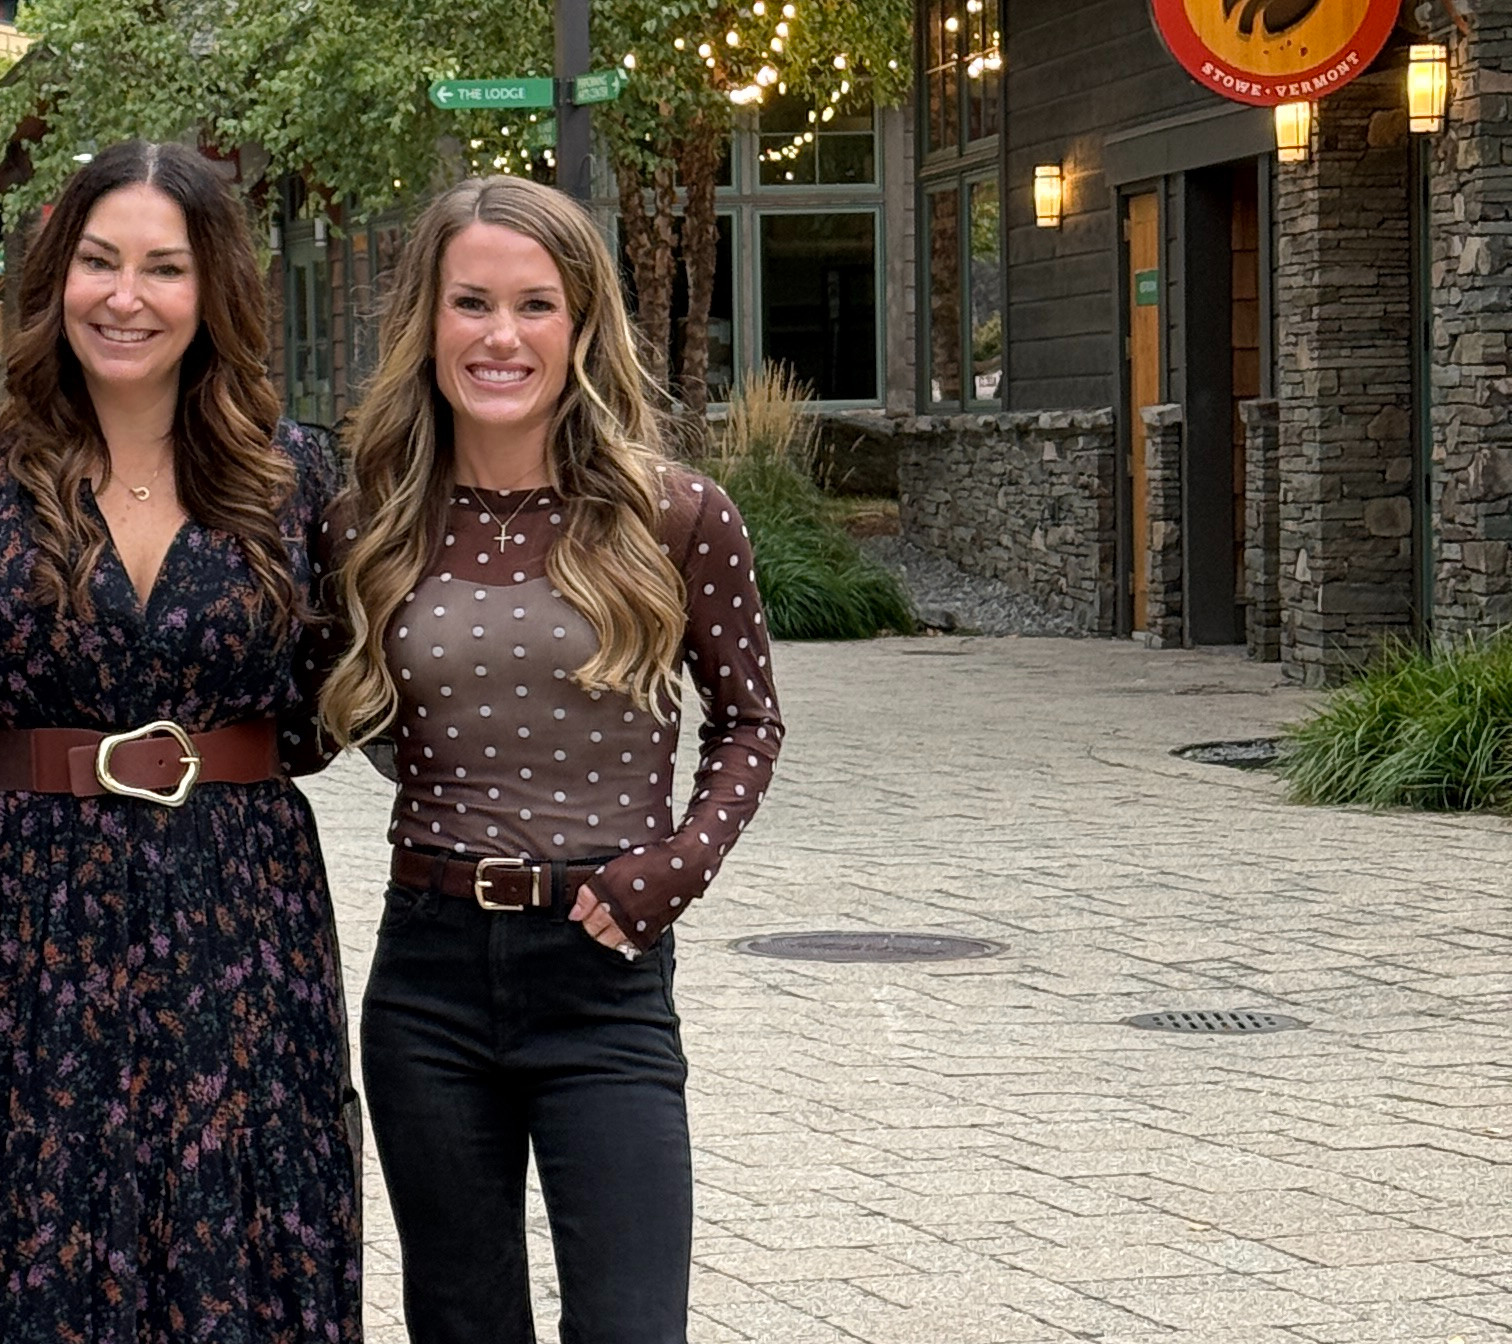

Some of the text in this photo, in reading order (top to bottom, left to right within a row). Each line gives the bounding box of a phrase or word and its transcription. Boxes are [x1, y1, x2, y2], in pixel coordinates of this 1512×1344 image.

[1201, 51, 1360, 98] STOWE VERMONT
[456, 87, 526, 101] THE LODGE
